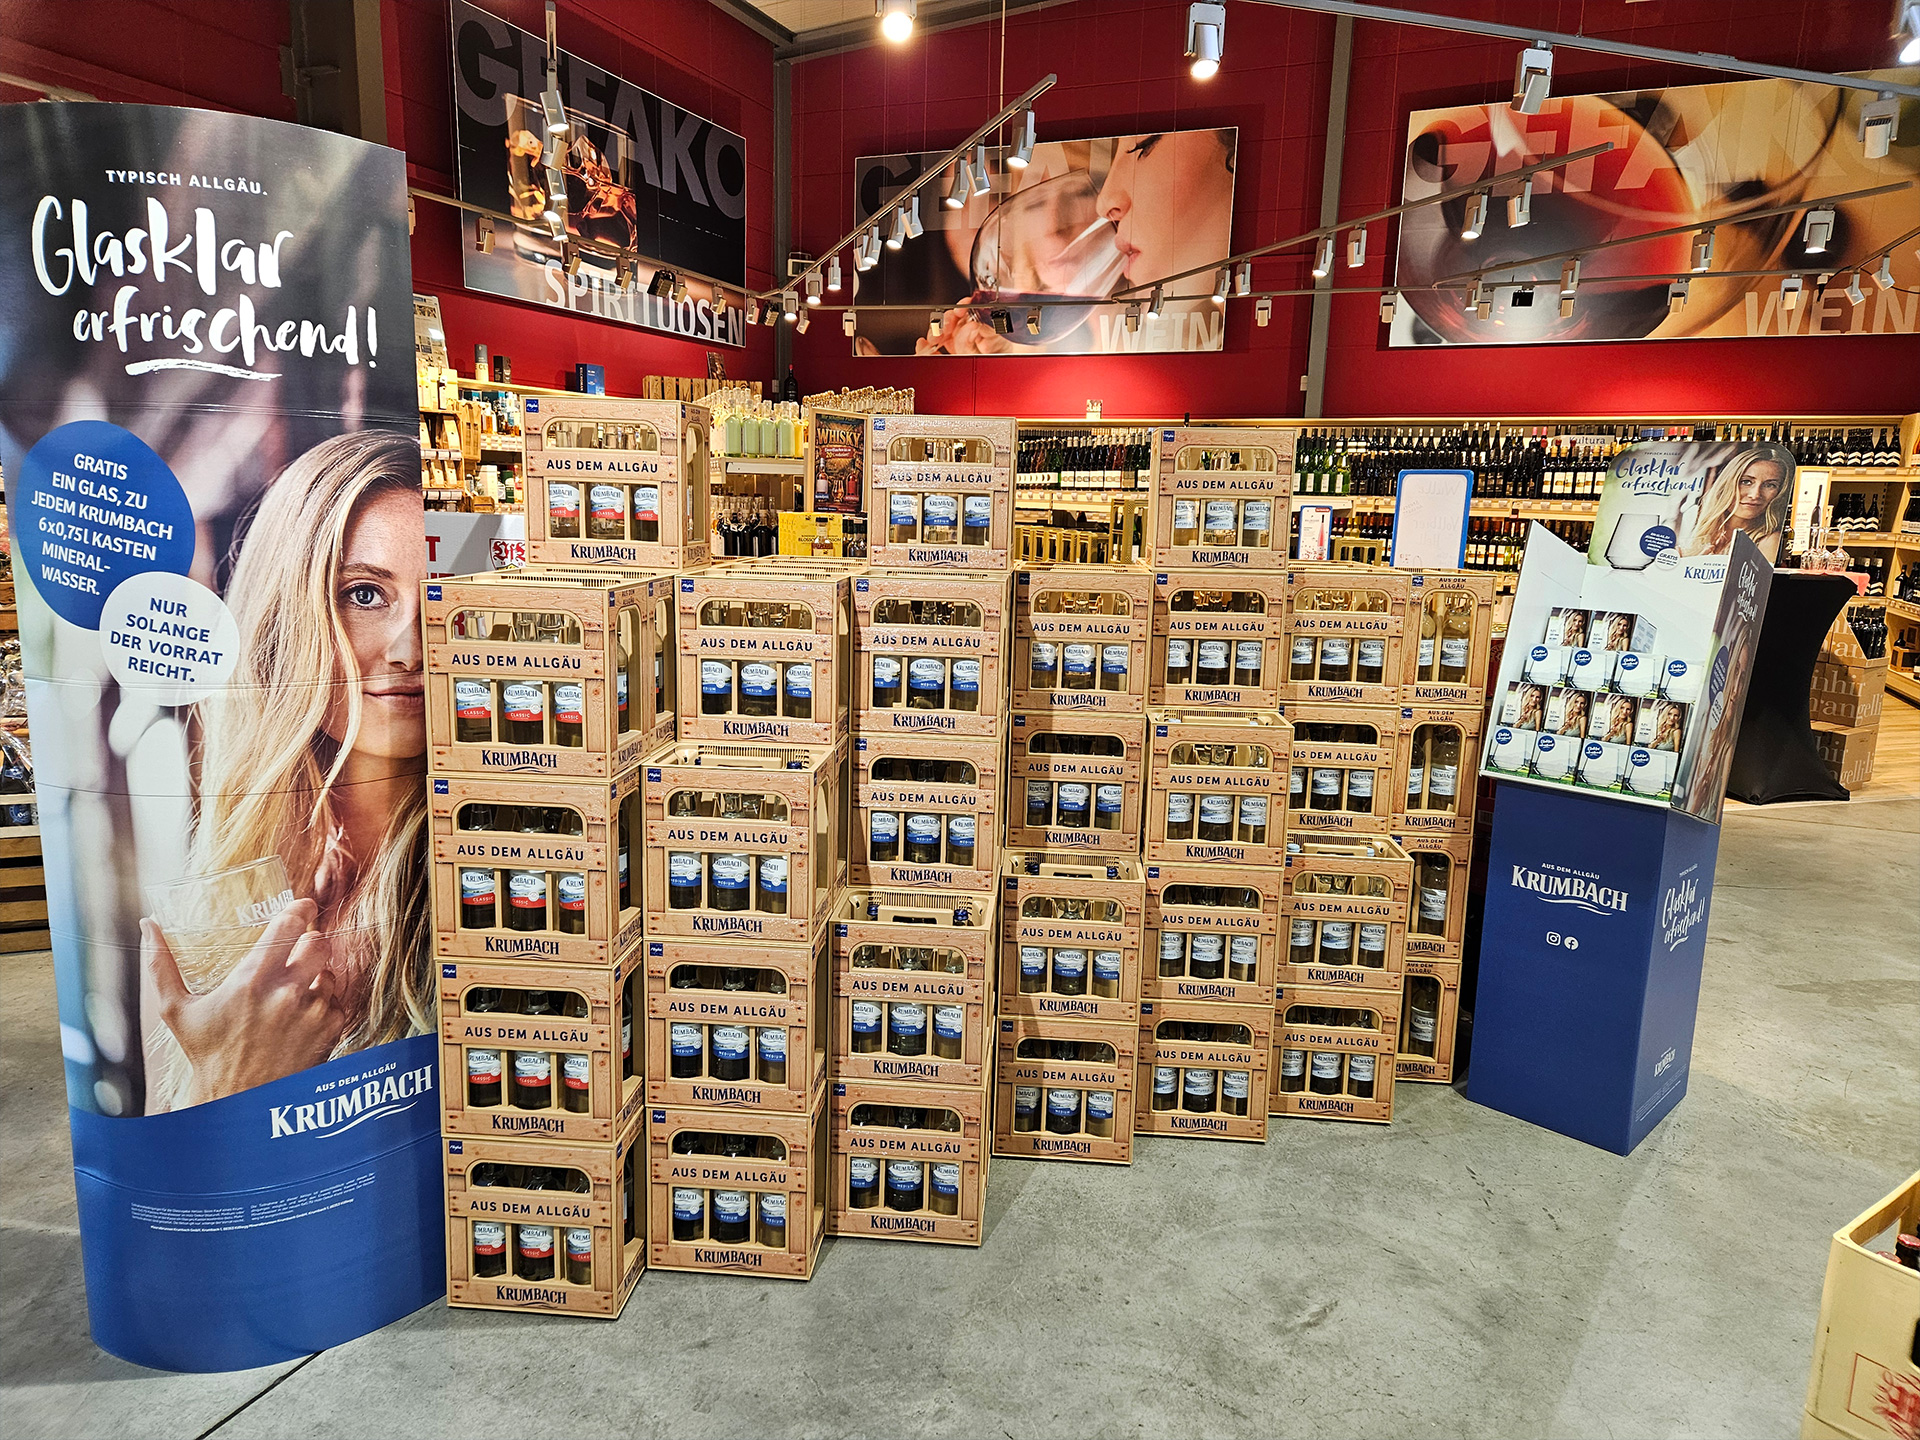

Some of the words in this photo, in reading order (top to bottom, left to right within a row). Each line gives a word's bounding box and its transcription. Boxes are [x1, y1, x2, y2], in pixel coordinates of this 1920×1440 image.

[106, 169, 182, 186] TYPISCH
[189, 174, 268, 196] ALLGÄU.
[32, 195, 294, 296] Glasklar
[544, 258, 744, 346] SPIRITUOSEN
[1745, 285, 1920, 336] WEIN
[73, 286, 378, 368] erfrischend!
[1100, 311, 1220, 352] WEIN
[816, 428, 861, 448] WHISKY
[74, 454, 128, 480] GRATIS
[546, 459, 571, 470] AUS
[576, 460, 602, 471] DEM
[608, 462, 658, 473] ALLGÄU
[1616, 456, 1685, 478] Glasklar
[890, 473, 912, 482] AUS
[917, 472, 941, 482] DEM
[945, 472, 992, 484] ALLGÄU
[1176, 480, 1198, 489] AUS
[1202, 480, 1225, 489] DEM
[1230, 481, 1274, 490] ALLGÄU
[1622, 475, 1703, 493] erfrischend!
[52, 472, 76, 491] EIN
[78, 480, 122, 506] GLAS,
[124, 491, 148, 509] ZU
[31, 490, 76, 516] JEDEM
[78, 503, 173, 540] KRUMBACH
[38, 517, 89, 544] 6x0,75l
[92, 532, 156, 561] KASTEN
[42, 541, 111, 573] MINERAL-
[572, 544, 636, 560] KRUMBACH
[909, 549, 968, 562] KRUMBACH
[1192, 551, 1248, 563] KRUMBACH
[41, 564, 100, 595] WASSER.
[150, 597, 187, 618] NUR
[125, 614, 210, 642] SOLANGE
[1032, 622, 1054, 632] AUS
[1058, 623, 1082, 632] DEM
[1086, 624, 1130, 634] ALLGÄU
[1170, 622, 1191, 630] AUS
[1195, 622, 1218, 630] DEM
[1222, 622, 1264, 632] ALLGÄU
[1294, 620, 1315, 628] AUS
[1319, 620, 1342, 628] DEM
[1345, 621, 1388, 630] ALLGÄU
[110, 630, 142, 650] DER
[148, 640, 223, 665] VORRAT
[700, 638, 725, 648] AUS
[730, 639, 757, 649] DEM
[762, 640, 812, 652] ALLGÄU
[873, 635, 897, 645] AUS
[902, 636, 927, 646] DEM
[932, 637, 980, 648] ALLGÄU
[128, 656, 195, 682] REICHT.
[452, 654, 480, 666] AUS
[486, 655, 517, 667] DEM
[523, 655, 581, 670] ALLGÄU
[1049, 693, 1106, 706] KRUMBACH
[1185, 690, 1240, 702] KRUMBACH
[1308, 686, 1362, 698] KRUMBACH
[1415, 687, 1467, 699] KRUMBACH
[724, 721, 788, 736] KRUMBACH
[894, 714, 955, 728] KRUMBACH
[482, 750, 556, 768] KRUMBACH
[1170, 775, 1192, 784] AUS
[1196, 776, 1220, 785] DEM
[1224, 777, 1270, 787] ALLGÄU
[1405, 816, 1456, 828] KRUMBACH
[668, 830, 694, 840] AUS
[700, 830, 728, 841] DEM
[734, 831, 788, 844] ALLGÄU
[457, 844, 485, 856] AUS
[491, 846, 521, 858] DEM
[527, 847, 584, 861] ALLGÄU
[1186, 846, 1244, 859] KRUMBACH
[1542, 862, 1555, 870] AUS
[1557, 865, 1571, 874] DEM
[1573, 868, 1600, 880] ALLGÄU
[1511, 865, 1629, 912] KRUMBACH
[236, 888, 294, 925] KRUMB
[1293, 902, 1316, 912] AUS
[1319, 904, 1342, 912] DEM
[1346, 905, 1390, 916] ALLGÄU
[1662, 878, 1699, 928] Glasklar
[693, 916, 762, 932] KRUMBACH
[1021, 928, 1044, 937] AUS
[1048, 929, 1072, 938] DEM
[1076, 930, 1122, 942] ALLGÄU
[486, 937, 558, 954] KRUMBACH
[1308, 969, 1364, 982] KRUMBACH
[852, 980, 877, 991] AUS
[882, 982, 908, 992] DEM
[914, 983, 964, 996] ALLGÄU
[1040, 999, 1098, 1014] KRUMBACH
[1284, 1034, 1306, 1043] AUS
[1310, 1035, 1332, 1044] DEM
[1336, 1037, 1378, 1048] ALLGÄU
[1154, 1050, 1176, 1059] AUS
[1180, 1051, 1204, 1060] DEM
[1208, 1052, 1251, 1063] ALLGÄU
[874, 1060, 938, 1076] KRUMBACH
[315, 1080, 336, 1094] AUS
[338, 1073, 359, 1087] DEM
[361, 1062, 397, 1081] ALLGÄU
[269, 1064, 433, 1140] KRUMBACH
[1299, 1098, 1353, 1112] KRUMBACH
[1171, 1117, 1227, 1131] KRUMBACH
[850, 1138, 874, 1148] AUS
[880, 1140, 906, 1150] DEM
[910, 1142, 960, 1154] ALLGÄU
[672, 1167, 697, 1178] AUS
[702, 1169, 730, 1180] DEM
[734, 1171, 786, 1184] ALLGÄU
[470, 1200, 497, 1212] AUS
[502, 1202, 530, 1214] DEM
[536, 1205, 590, 1218] ALLGÄU
[871, 1216, 935, 1232] KRUMBACH
[695, 1249, 762, 1266] KRUMBACH
[497, 1286, 566, 1304] KRUMBACH
